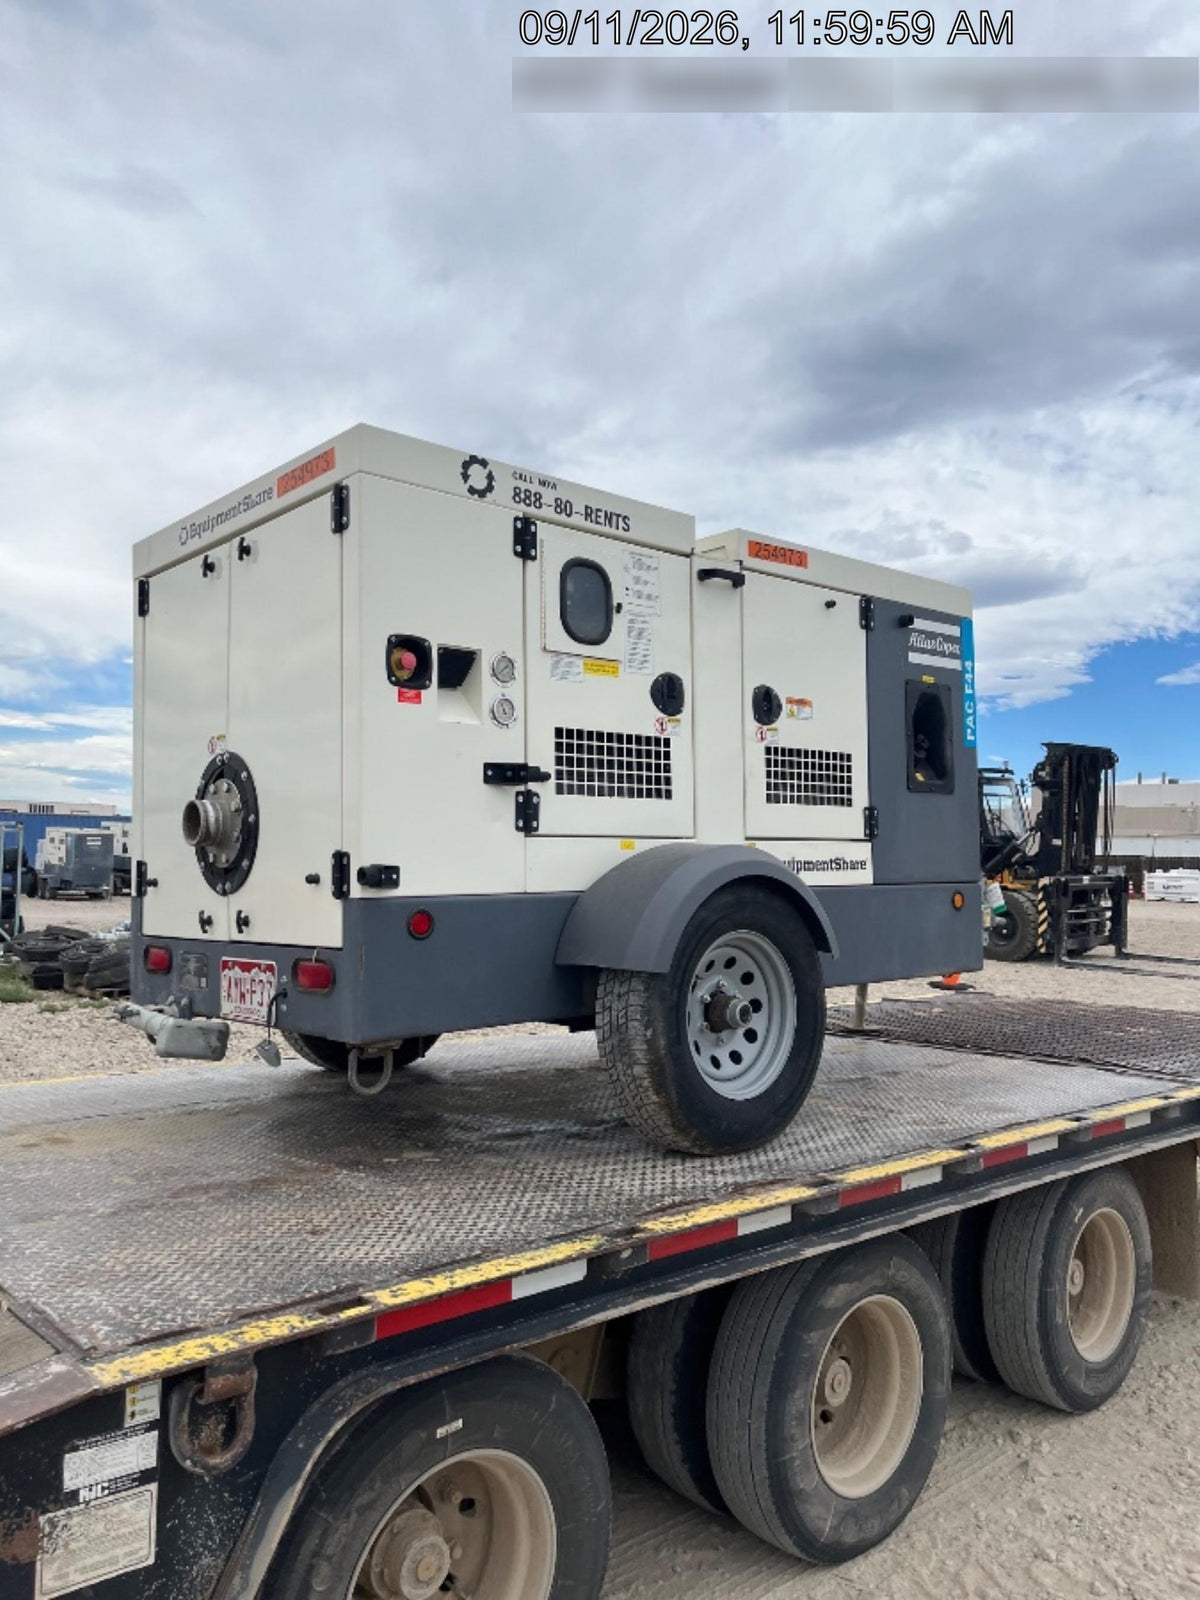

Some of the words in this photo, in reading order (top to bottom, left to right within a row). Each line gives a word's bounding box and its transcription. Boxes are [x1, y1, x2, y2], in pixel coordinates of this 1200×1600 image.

[511, 470, 534, 485] CALL
[189, 485, 274, 541] EquipmentShare
[511, 486, 631, 533] 888-80-RENTS
[754, 541, 804, 567] 254973
[964, 660, 974, 695] F44
[965, 701, 975, 741] PAC
